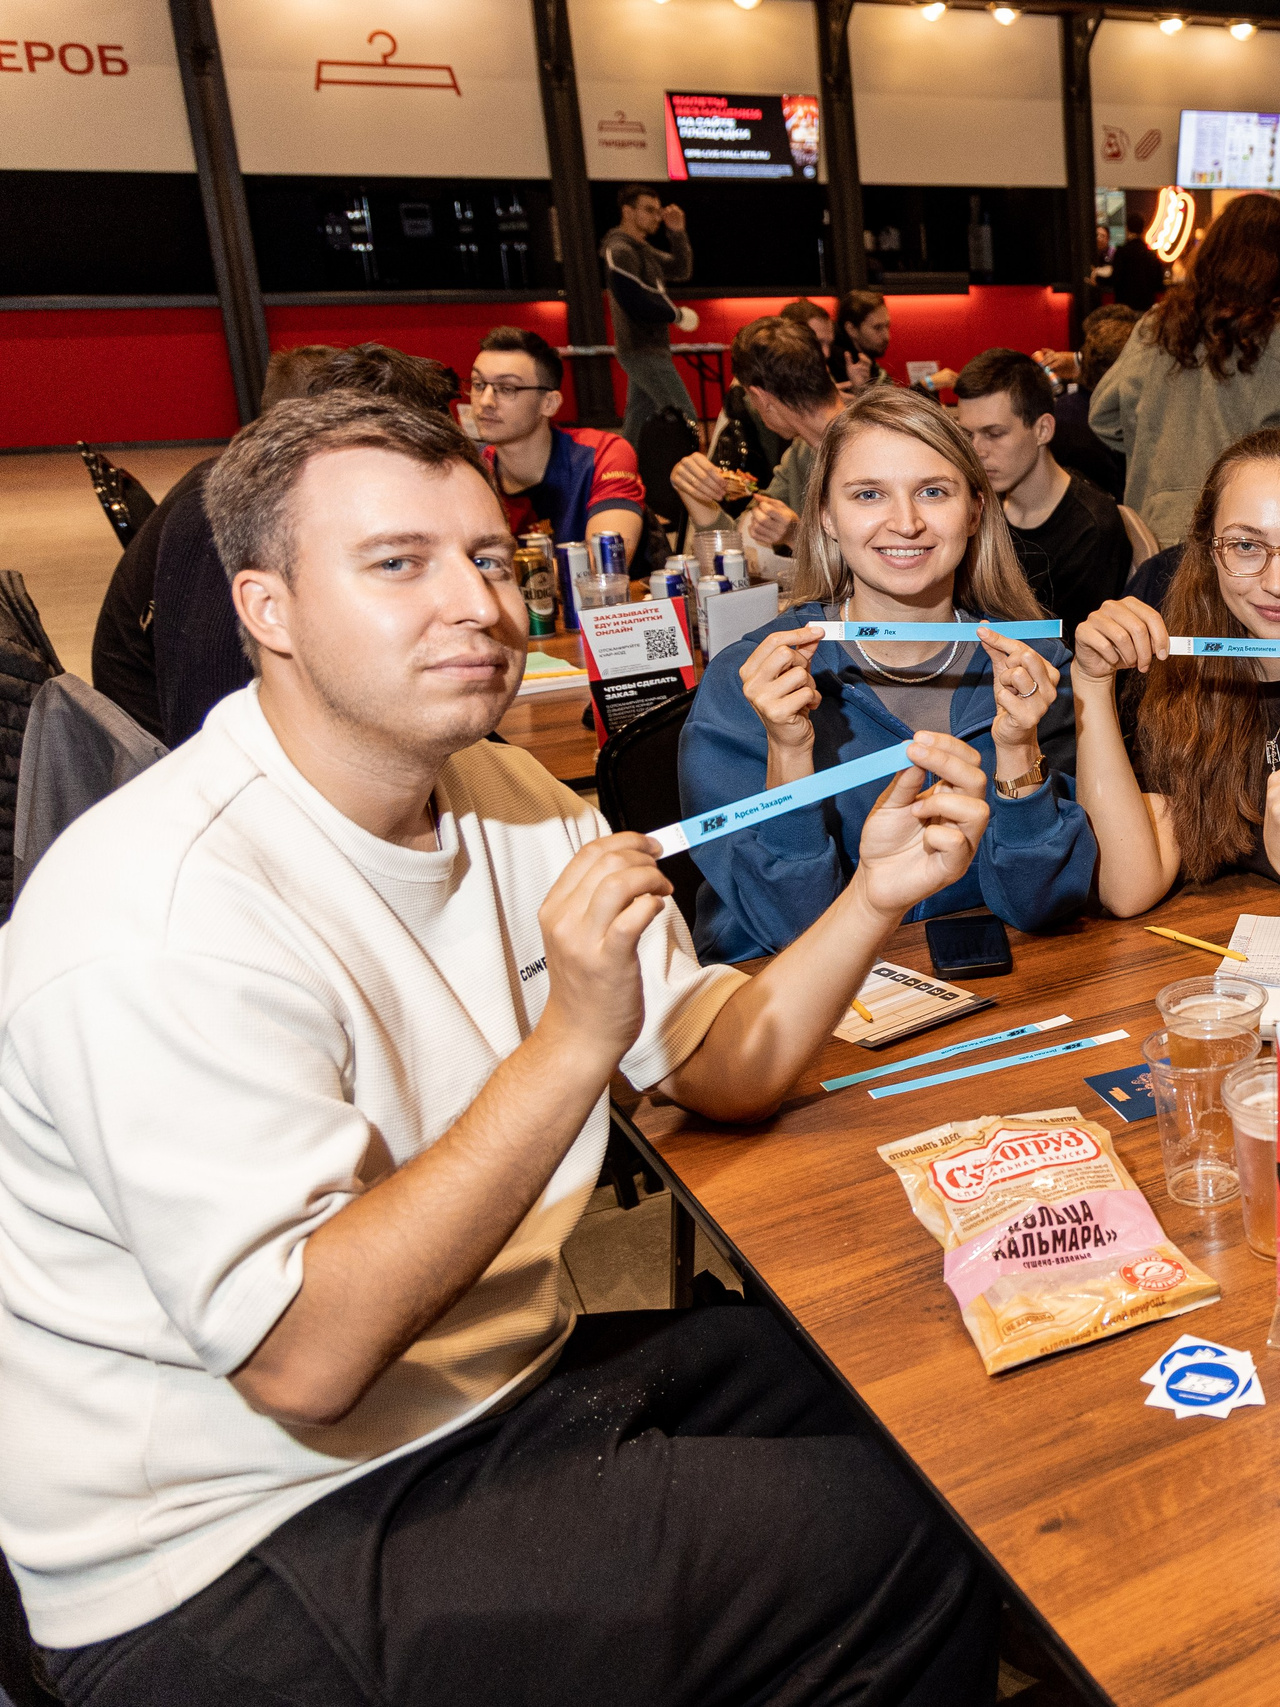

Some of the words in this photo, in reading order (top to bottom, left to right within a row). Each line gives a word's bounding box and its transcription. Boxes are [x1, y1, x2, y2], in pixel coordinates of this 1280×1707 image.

[593, 607, 659, 622] ЗАКАЗЫВАЙТЕ
[621, 615, 663, 625] НАПИТКИ
[595, 626, 633, 637] ОНЛАЙН
[1227, 645, 1243, 653] Джуд
[603, 682, 636, 693] ЧТОБЫ
[636, 676, 678, 688] СДЕЛАТЬ
[604, 690, 638, 700] ЗАКАЗ:
[734, 805, 759, 821] Арсен
[760, 793, 794, 812] Захарян
[888, 1141, 939, 1161] ОТКРЫВАТЬ
[1042, 1149, 1089, 1163] ЗАКУСКА
